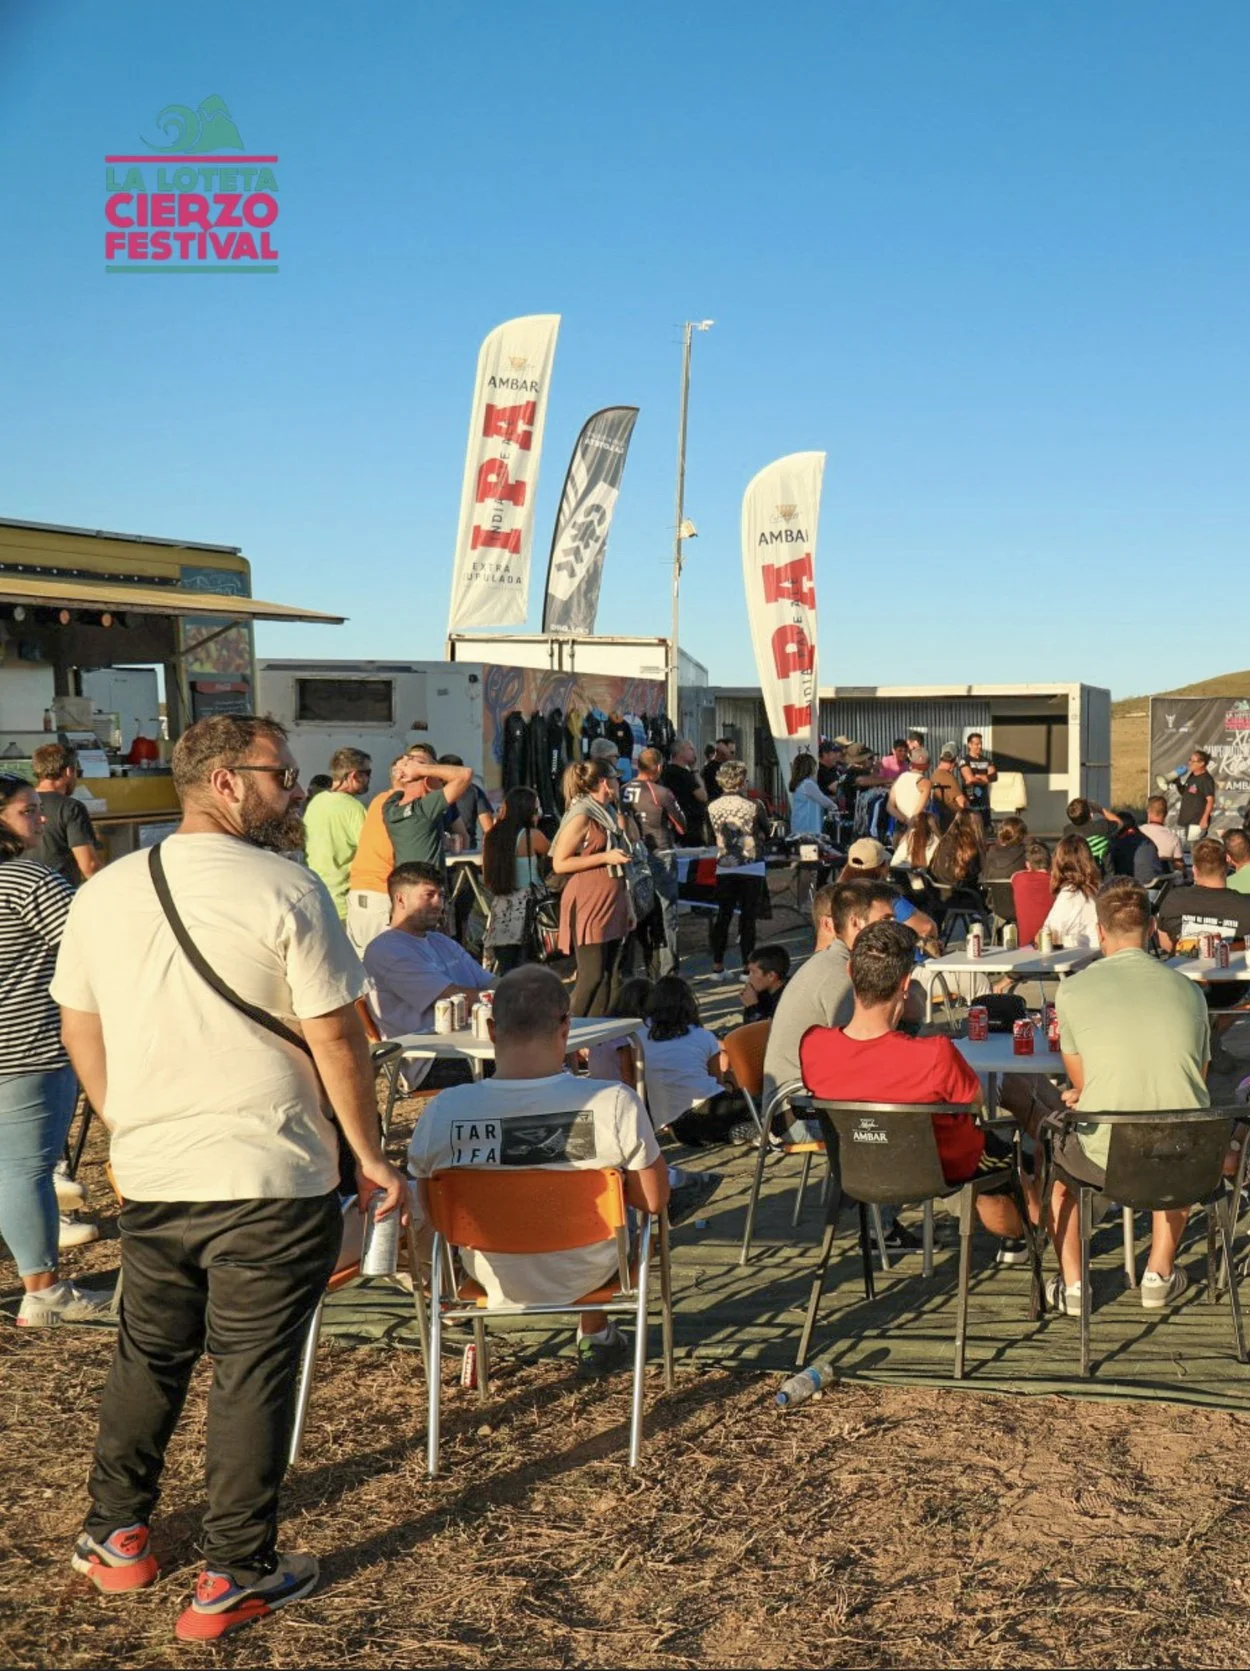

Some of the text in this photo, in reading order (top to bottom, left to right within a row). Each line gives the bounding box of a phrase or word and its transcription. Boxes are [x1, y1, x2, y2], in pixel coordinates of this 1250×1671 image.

[488, 375, 540, 393] AMBAR
[471, 400, 536, 554] IPA
[455, 1123, 497, 1141] TAR
[853, 1131, 889, 1142] AMBAR
